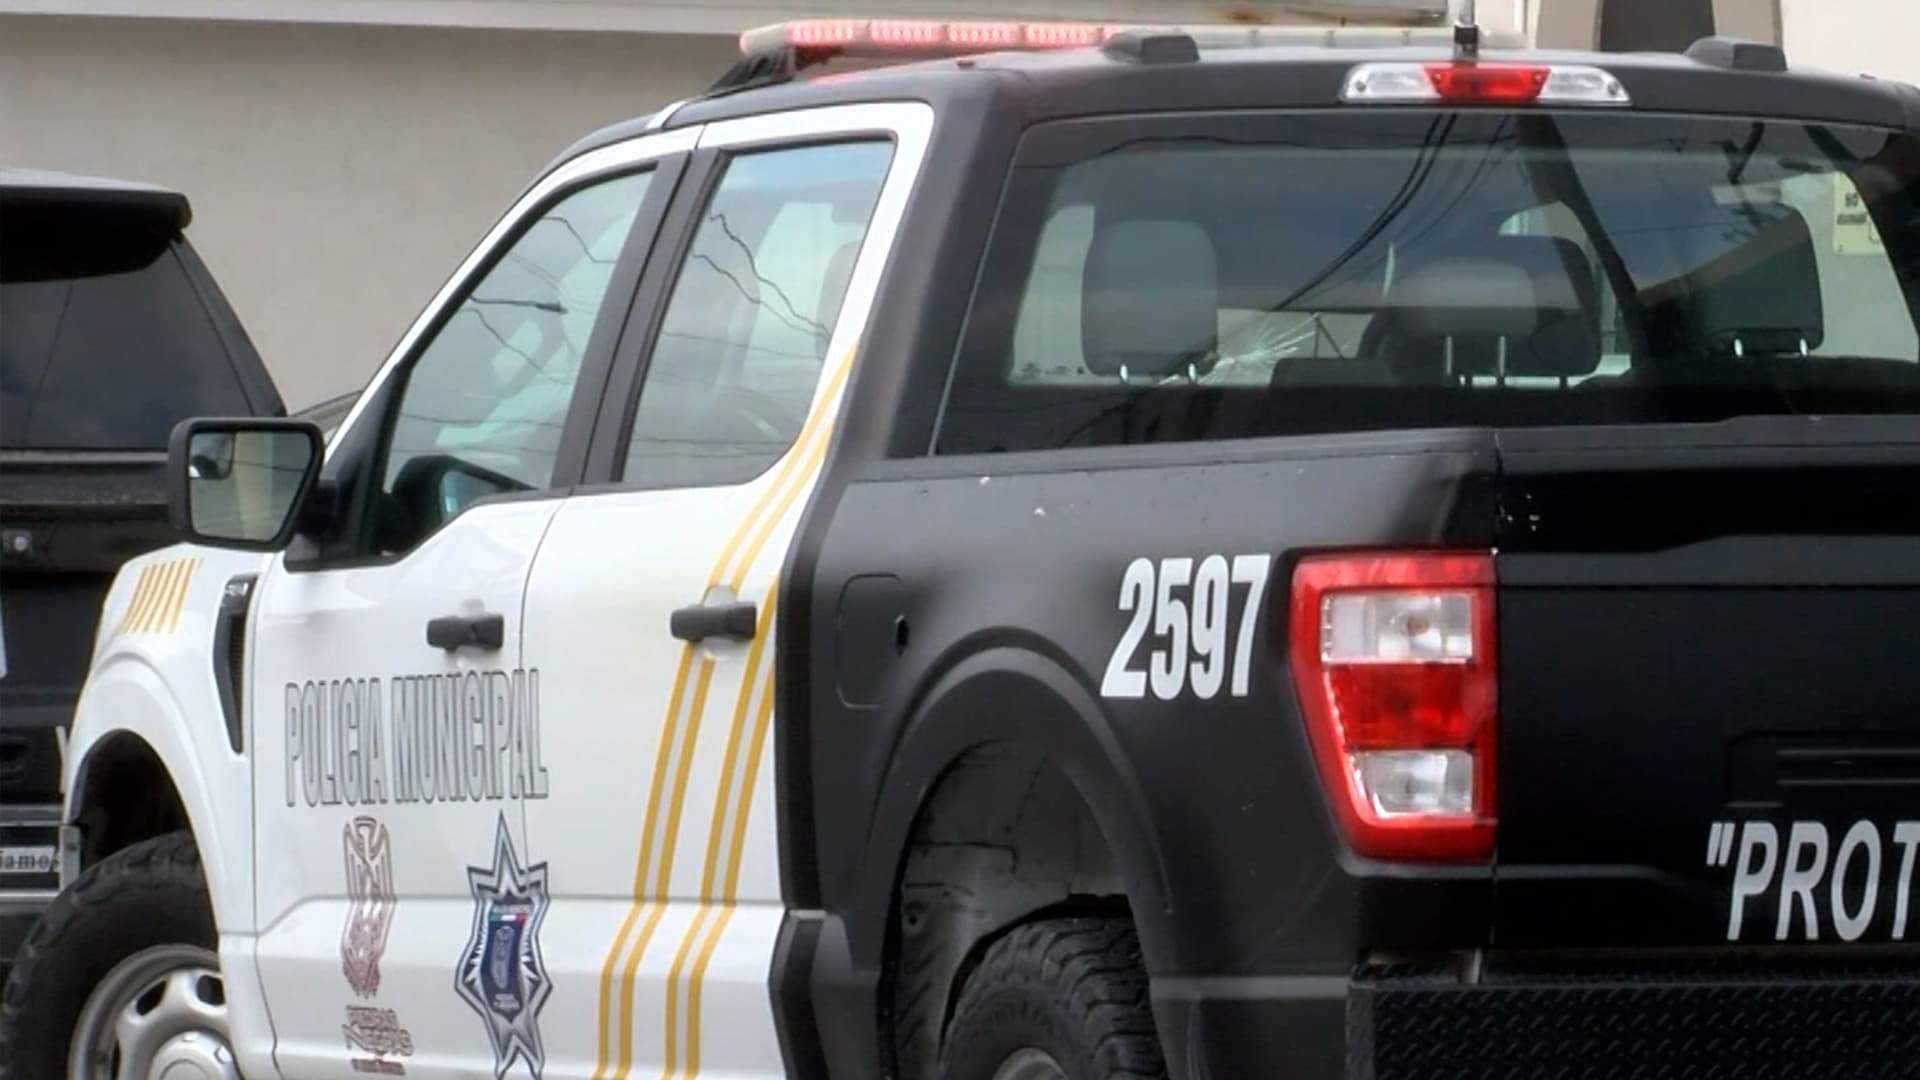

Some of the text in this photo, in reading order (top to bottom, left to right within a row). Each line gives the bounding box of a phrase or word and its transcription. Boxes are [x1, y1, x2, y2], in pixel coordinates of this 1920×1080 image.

[1101, 554, 1271, 700] 2597
[285, 668, 549, 807] POLICIA MUNICIPAL
